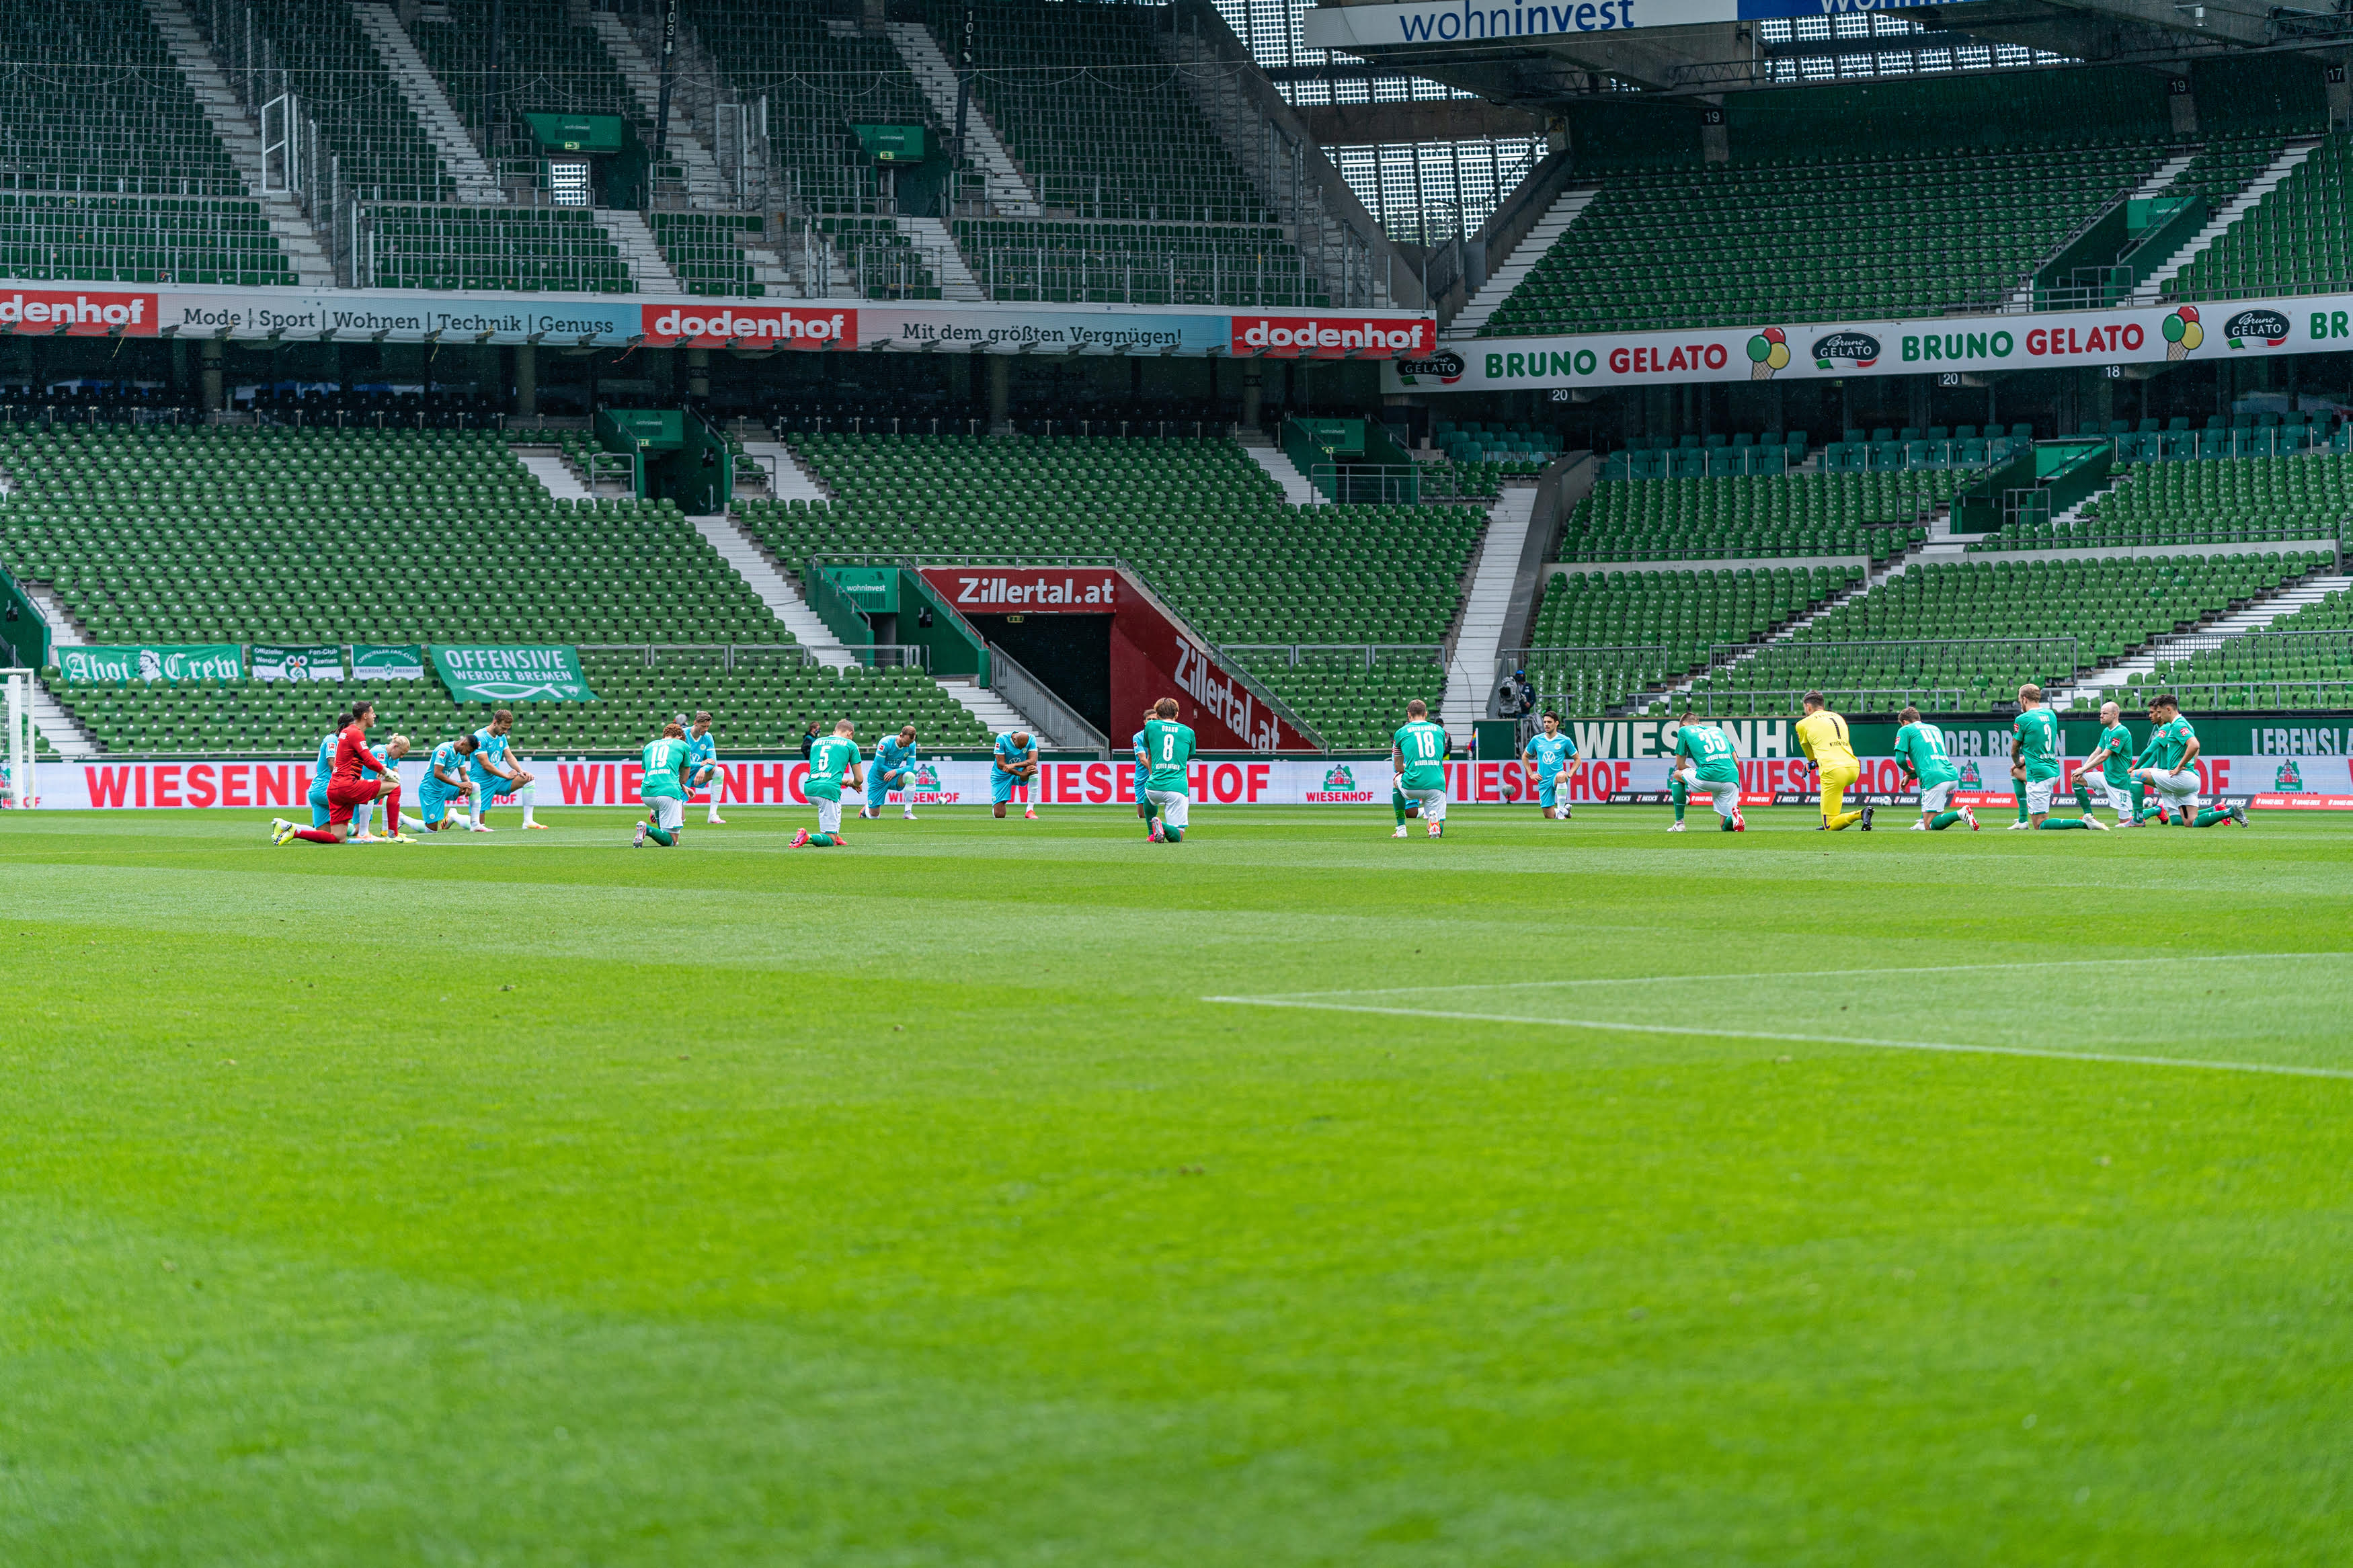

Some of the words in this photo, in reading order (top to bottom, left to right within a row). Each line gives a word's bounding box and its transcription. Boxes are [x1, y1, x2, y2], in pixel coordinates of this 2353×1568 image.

[966, 10, 974, 46] 101
[1400, 0, 1635, 42] wohninvest
[2328, 68, 2343, 81] 17
[2171, 80, 2186, 93] 19
[1705, 111, 1720, 123] 19
[184, 307, 242, 326] Mode
[259, 310, 316, 329] Sport
[333, 311, 420, 329] Wohnen
[438, 313, 522, 331] Technik
[539, 315, 614, 333] Genuss
[655, 310, 844, 339] dodenhof
[2232, 323, 2282, 336] GELATO
[2238, 313, 2276, 325] Bruno
[2310, 311, 2353, 339] BR
[903, 323, 935, 339] Mit
[941, 324, 984, 341] dem
[988, 325, 1064, 345] größten
[1070, 327, 1183, 347] Vergnügen!
[1244, 321, 1423, 348] dodenhof
[1827, 335, 1866, 347] Bruno
[1902, 330, 2013, 362] BRUNO
[2026, 323, 2144, 356] GELATO
[1486, 349, 1597, 378] BRUNO
[1609, 343, 1728, 374] GELATO
[1820, 345, 1872, 357] GELATO
[1405, 363, 1457, 374] GELATO
[1943, 373, 1958, 385] 20
[2106, 366, 2120, 378] 18
[1552, 389, 1568, 401] 20
[846, 584, 886, 592] wohninvest
[957, 577, 1114, 604] Zillertal.at
[254, 647, 285, 655] Offizieller
[255, 656, 278, 664] Werder
[444, 650, 567, 669] OFFENSIVE
[66, 652, 130, 682] Ahoi
[165, 652, 239, 680] Crew
[452, 671, 512, 681] WERDER
[514, 671, 573, 682] BREMEN
[1174, 636, 1280, 753] Zillertal.at
[1574, 721, 1794, 758] WIESNH
[1829, 718, 1841, 739] 1
[2044, 723, 2051, 751] 3
[1162, 733, 1174, 761] 8
[1414, 731, 1435, 757] 18
[1698, 731, 1726, 754] 35
[651, 745, 670, 769] 19
[819, 745, 832, 772] 5
[85, 765, 316, 807] WIESENH
[888, 792, 960, 802] WISENHOF
[1306, 791, 1374, 802] WIESENHOF
[2119, 792, 2127, 802] 30
